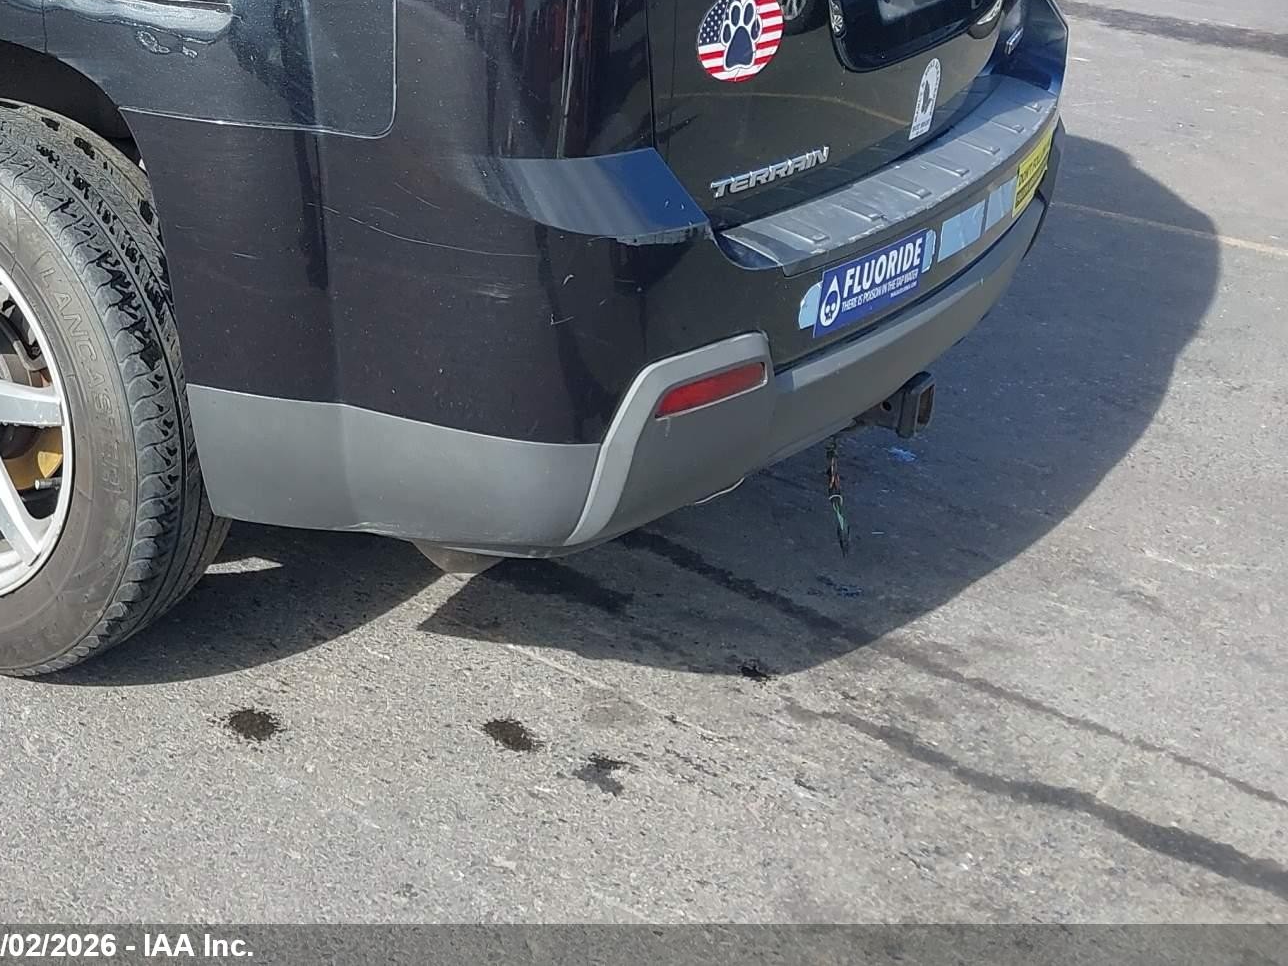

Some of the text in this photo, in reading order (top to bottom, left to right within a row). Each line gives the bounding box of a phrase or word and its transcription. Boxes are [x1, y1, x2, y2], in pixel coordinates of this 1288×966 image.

[710, 145, 830, 198] TERRAIN
[841, 298, 857, 312] THERE
[863, 288, 882, 303] POISON
[887, 280, 896, 292] THE
[904, 268, 919, 284] WATER
[843, 237, 923, 298] FLUORIDE
